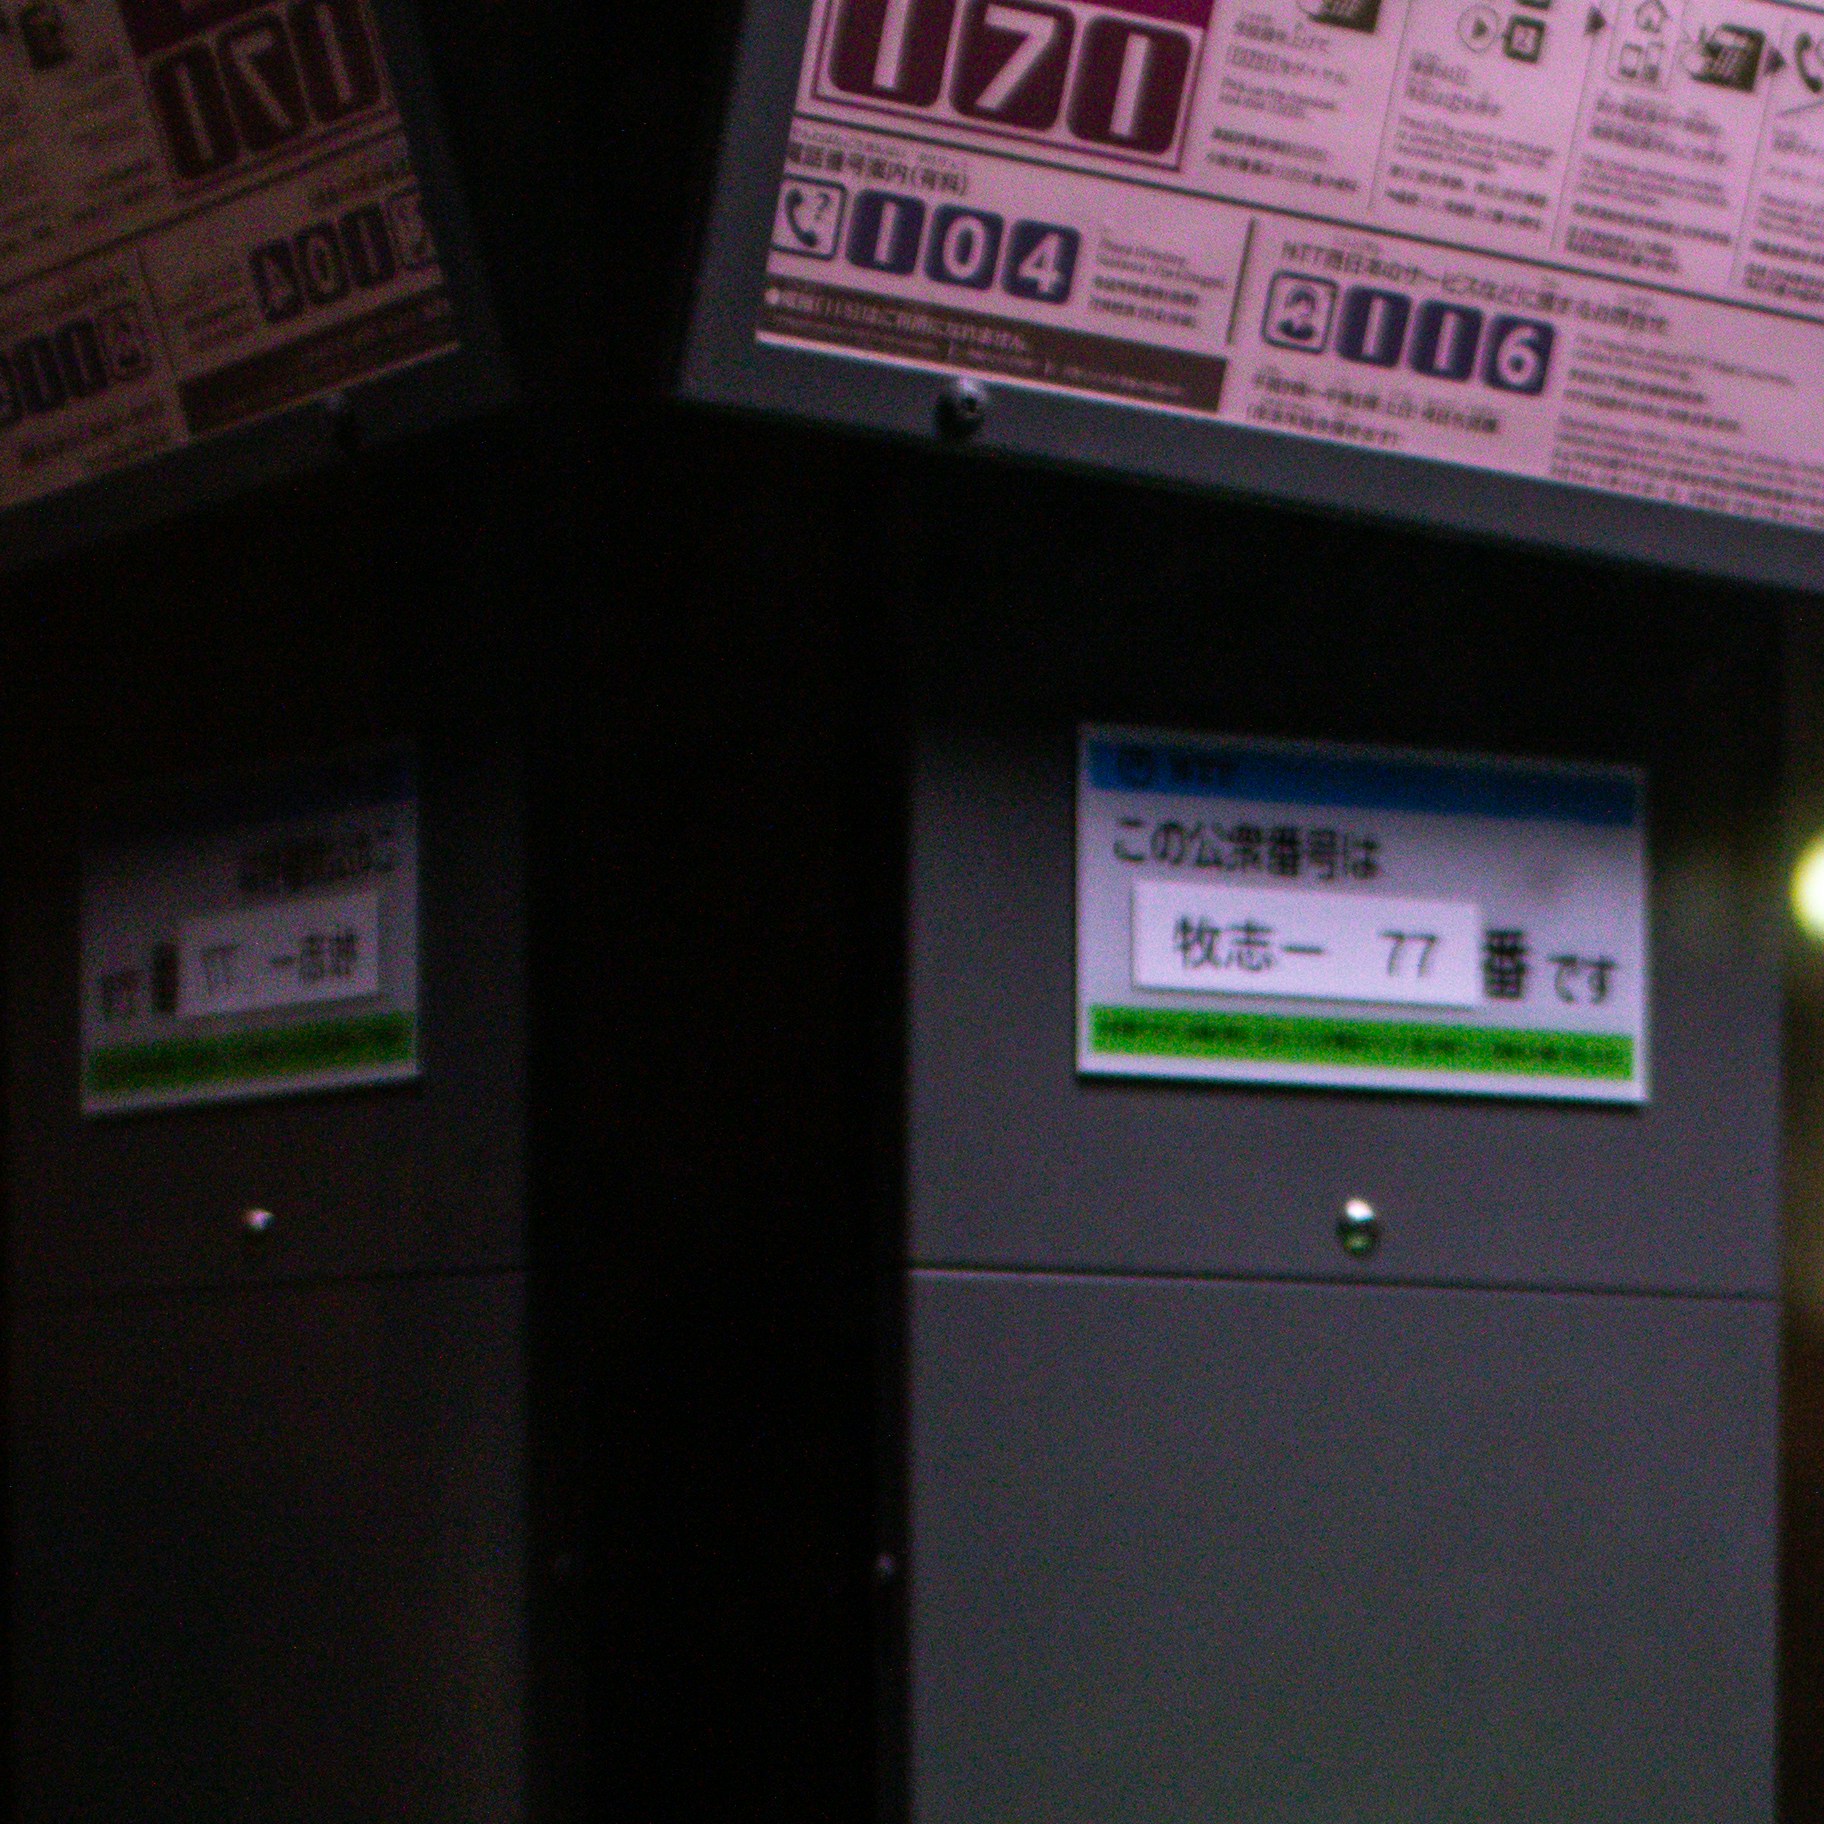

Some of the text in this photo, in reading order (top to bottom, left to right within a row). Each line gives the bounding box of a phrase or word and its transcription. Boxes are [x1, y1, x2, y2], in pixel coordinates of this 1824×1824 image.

[873, 0, 1146, 139] 171
[873, 201, 1063, 294] 104
[1361, 296, 1541, 386] 116
[1113, 817, 1385, 884] この公衆番号は
[1377, 929, 1441, 980] 77
